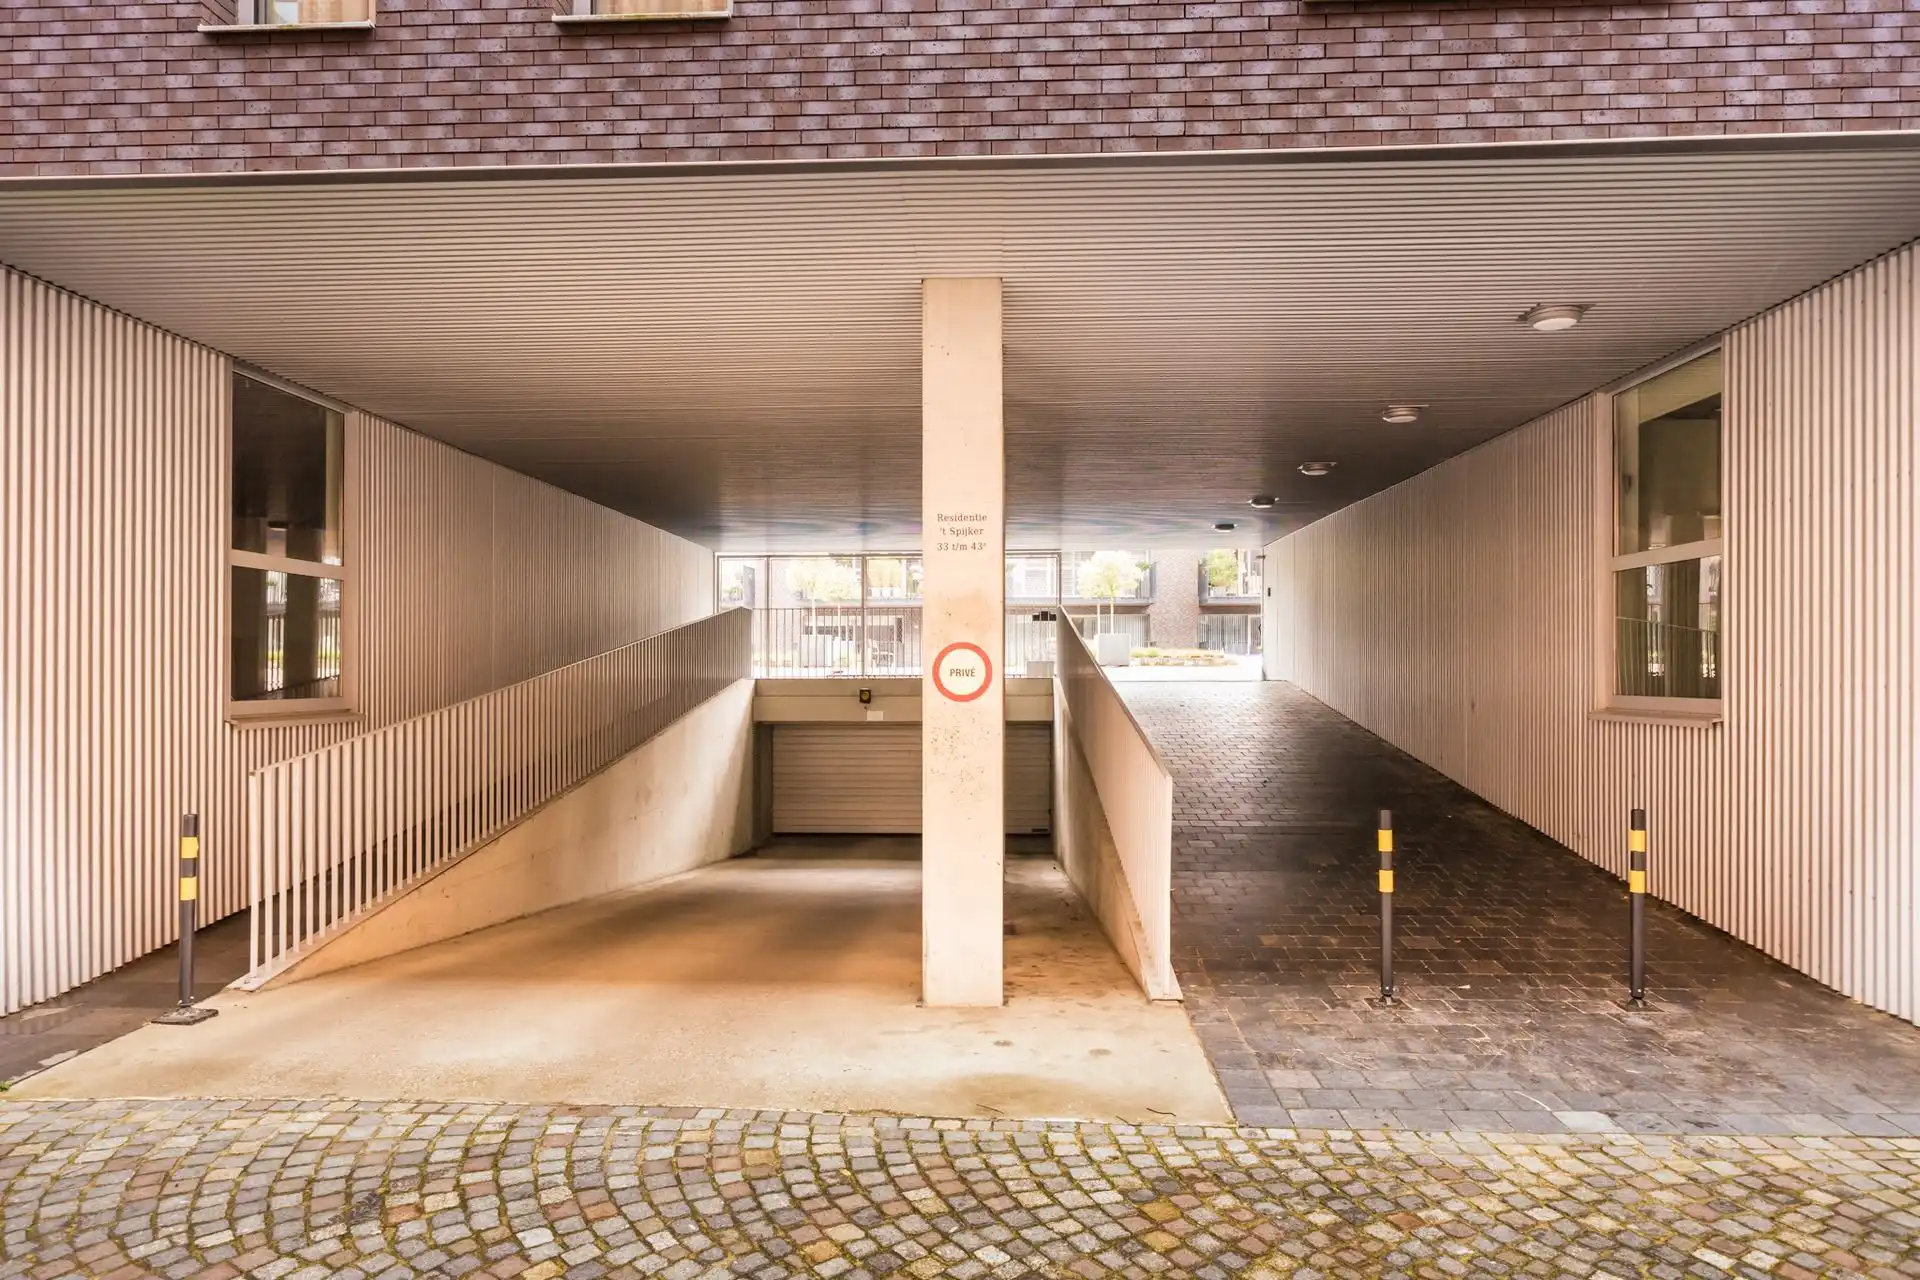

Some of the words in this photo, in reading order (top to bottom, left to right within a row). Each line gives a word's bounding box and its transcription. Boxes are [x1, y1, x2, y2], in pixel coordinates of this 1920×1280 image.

[937, 513, 988, 522] Residentie
[949, 526, 984, 537] Spijker
[937, 542, 949, 551] 33
[952, 542, 968, 551] t/m
[949, 666, 976, 677] PRIVÉ
